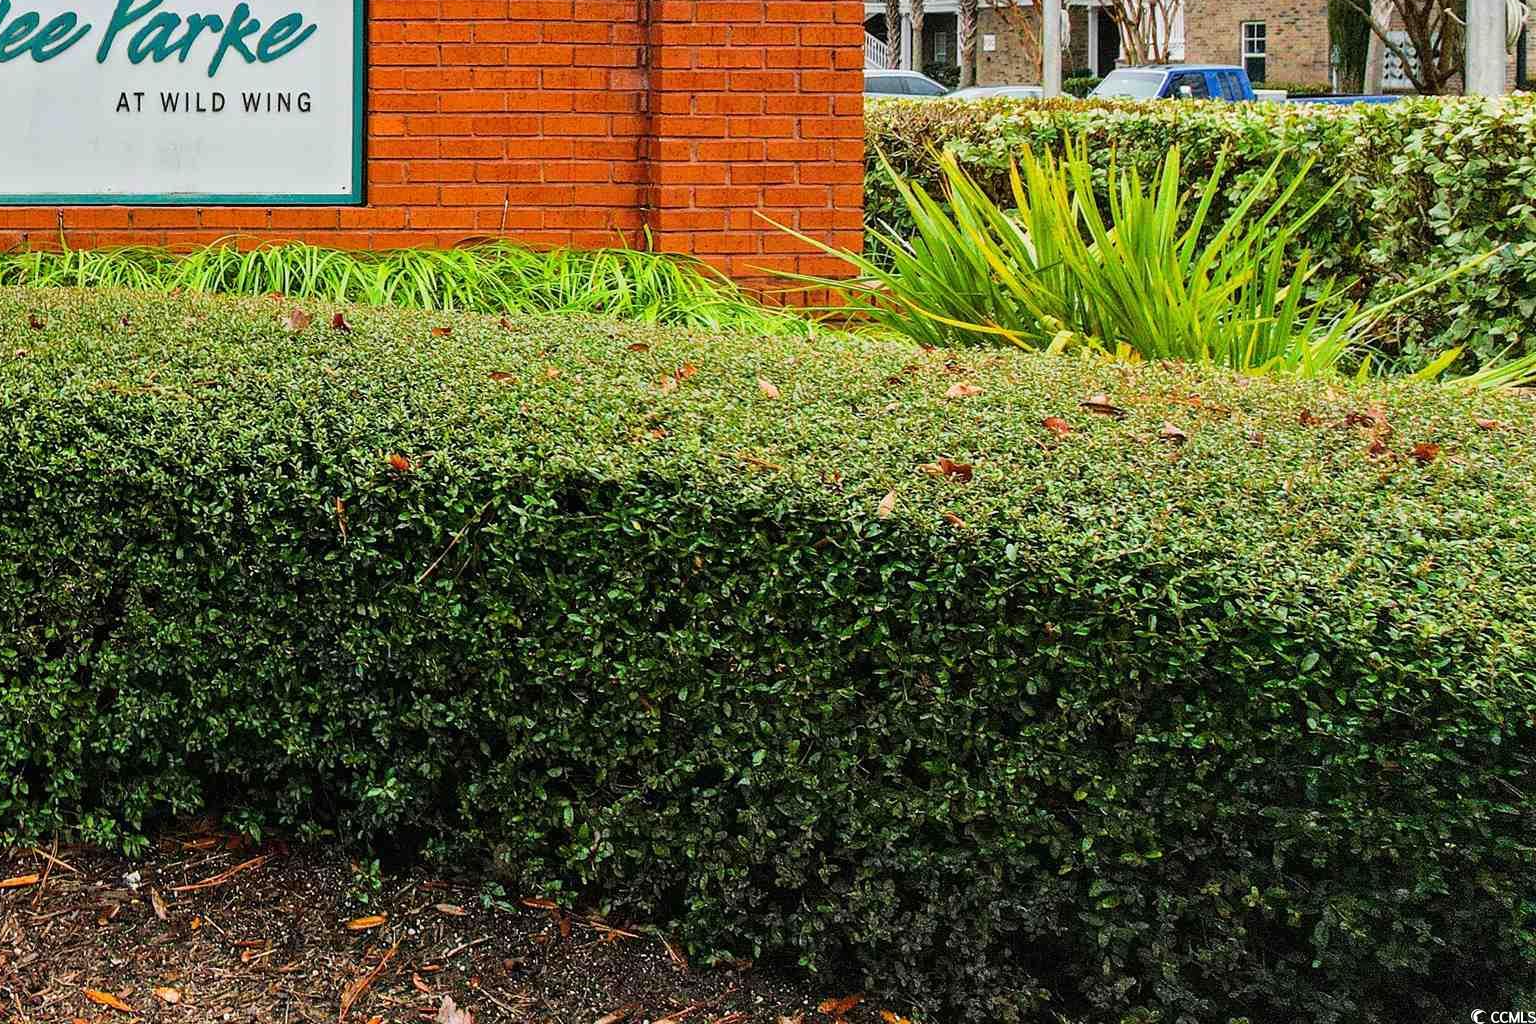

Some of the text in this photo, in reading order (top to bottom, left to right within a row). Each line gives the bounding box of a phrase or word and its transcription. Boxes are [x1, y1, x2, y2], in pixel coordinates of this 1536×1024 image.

[115, 92, 312, 113] AT WILD WING
